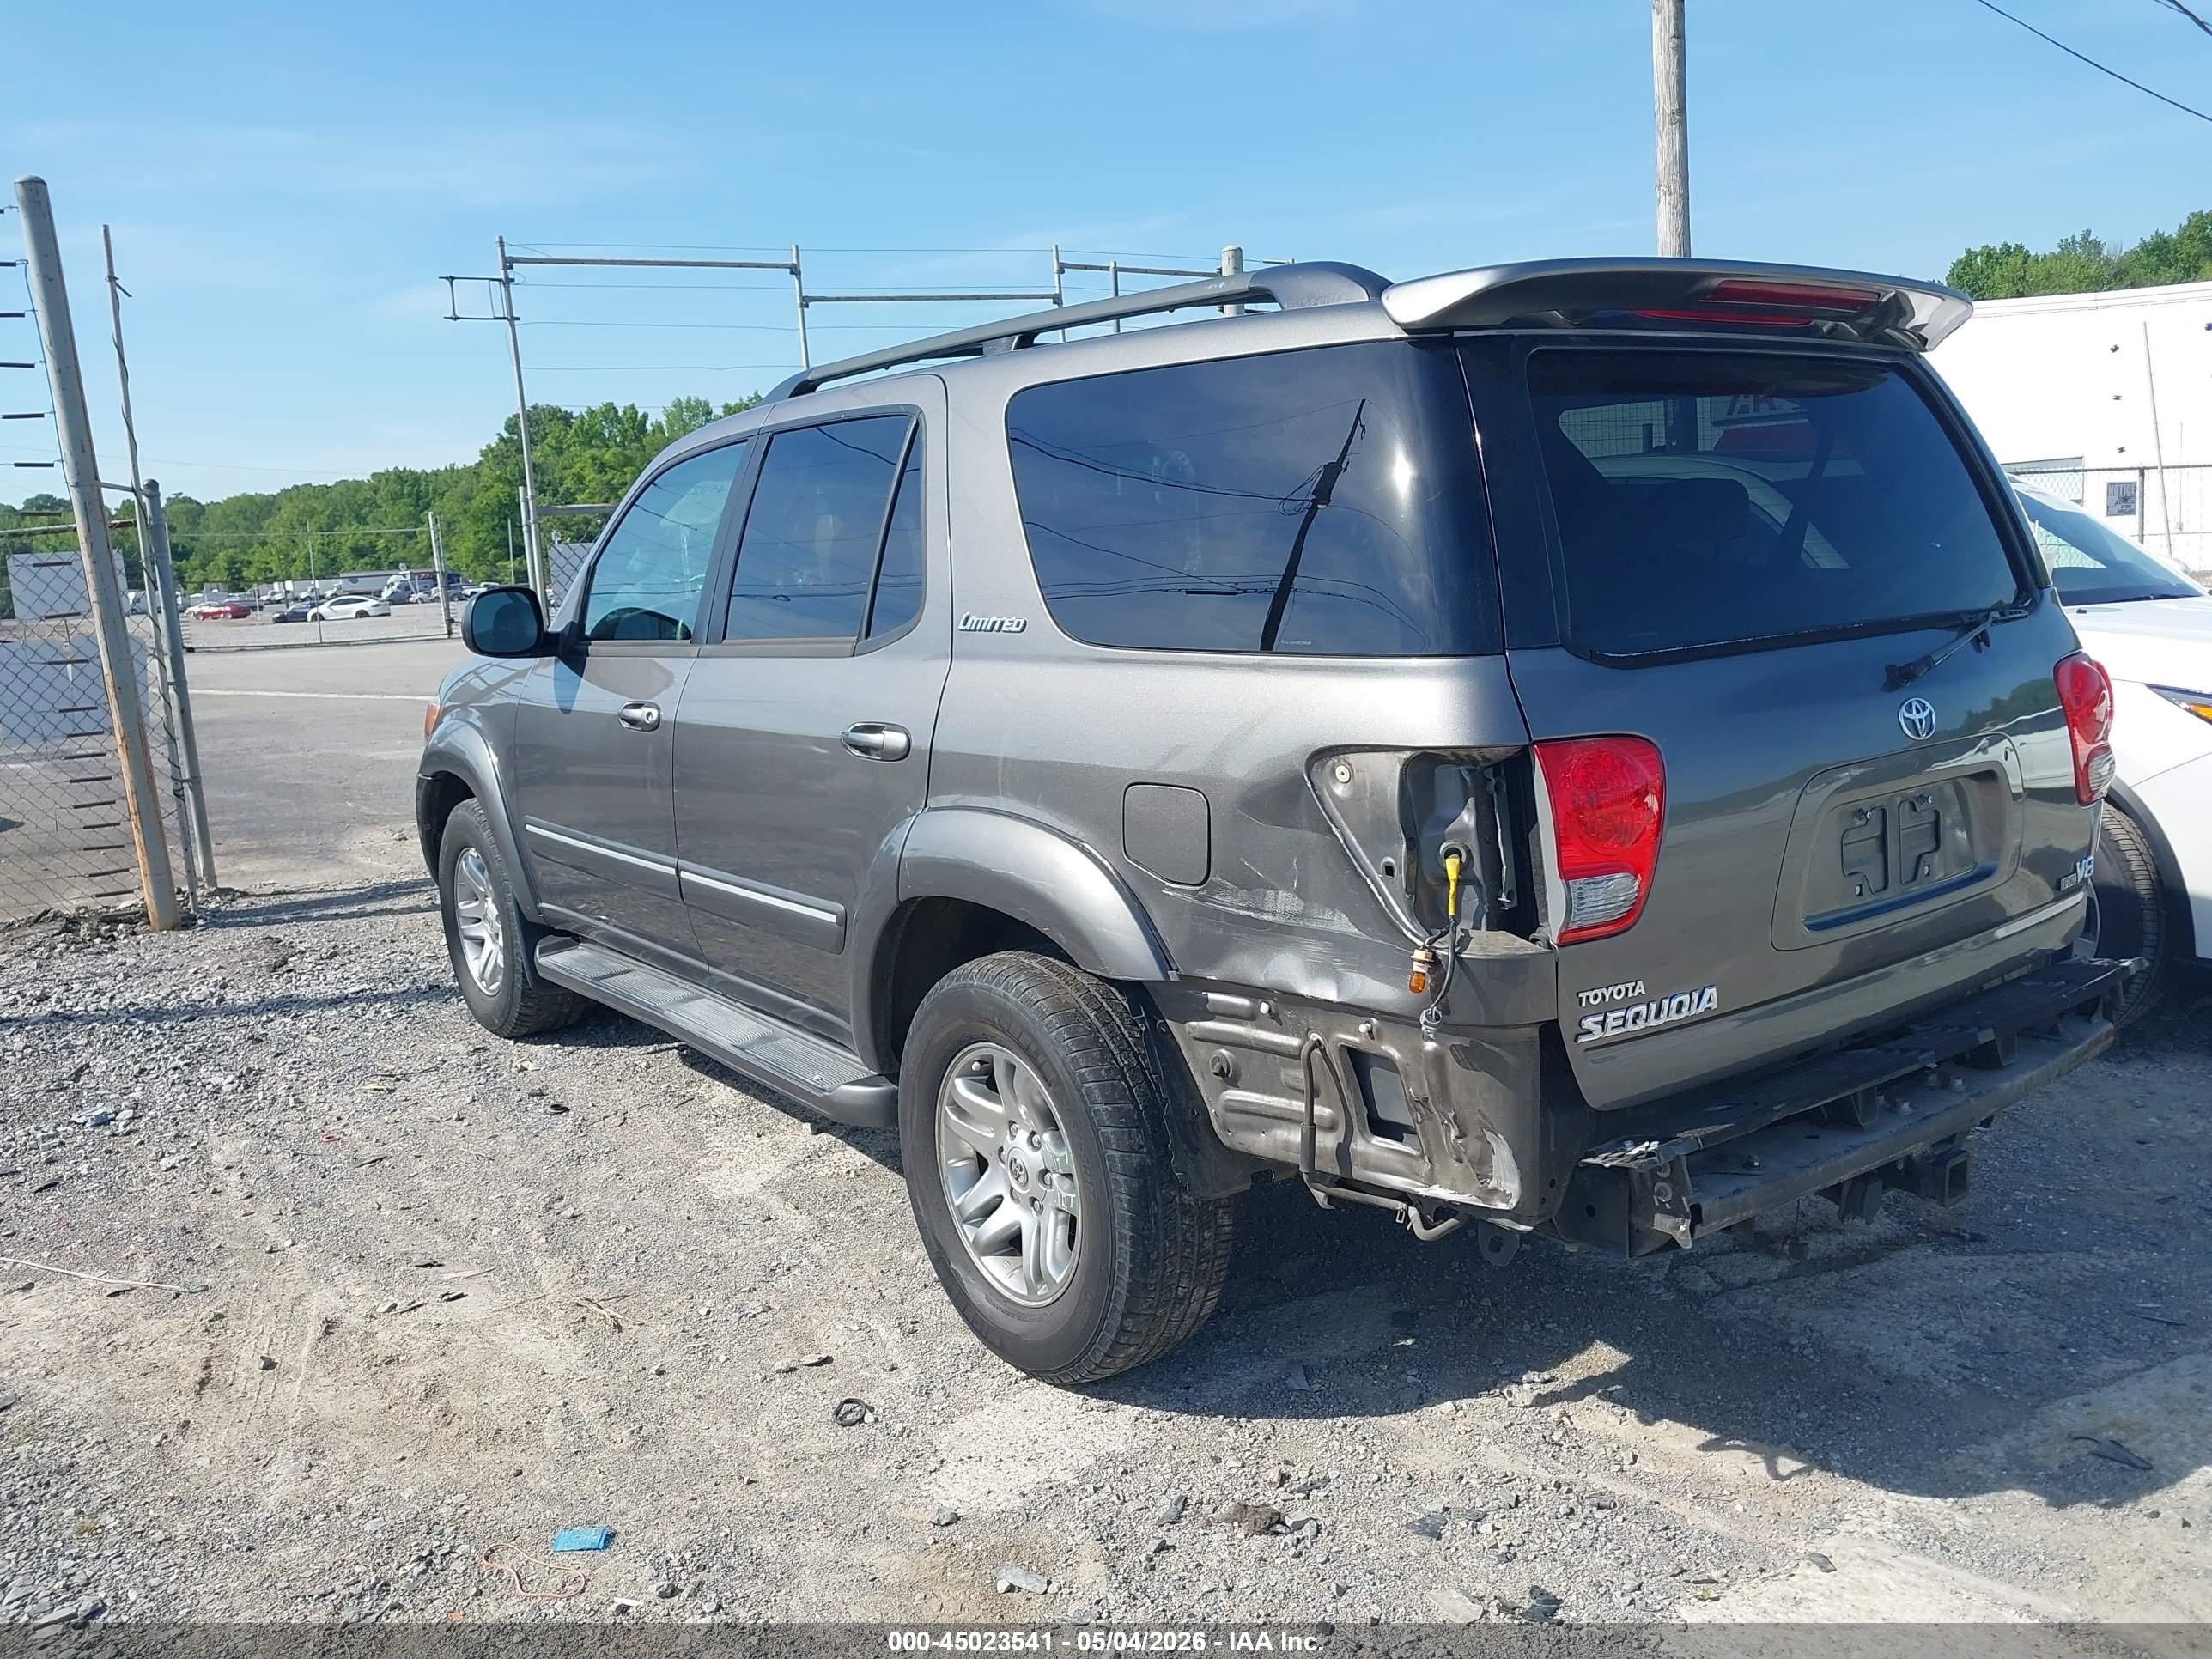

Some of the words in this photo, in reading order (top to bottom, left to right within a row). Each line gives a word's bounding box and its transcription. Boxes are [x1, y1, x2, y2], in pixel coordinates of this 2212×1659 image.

[2109, 483, 2136, 495] NOTICE
[2075, 856, 2094, 884] V8
[1577, 980, 1646, 1007] TOYOTA
[1576, 985, 1718, 1043] SEQUOIA
